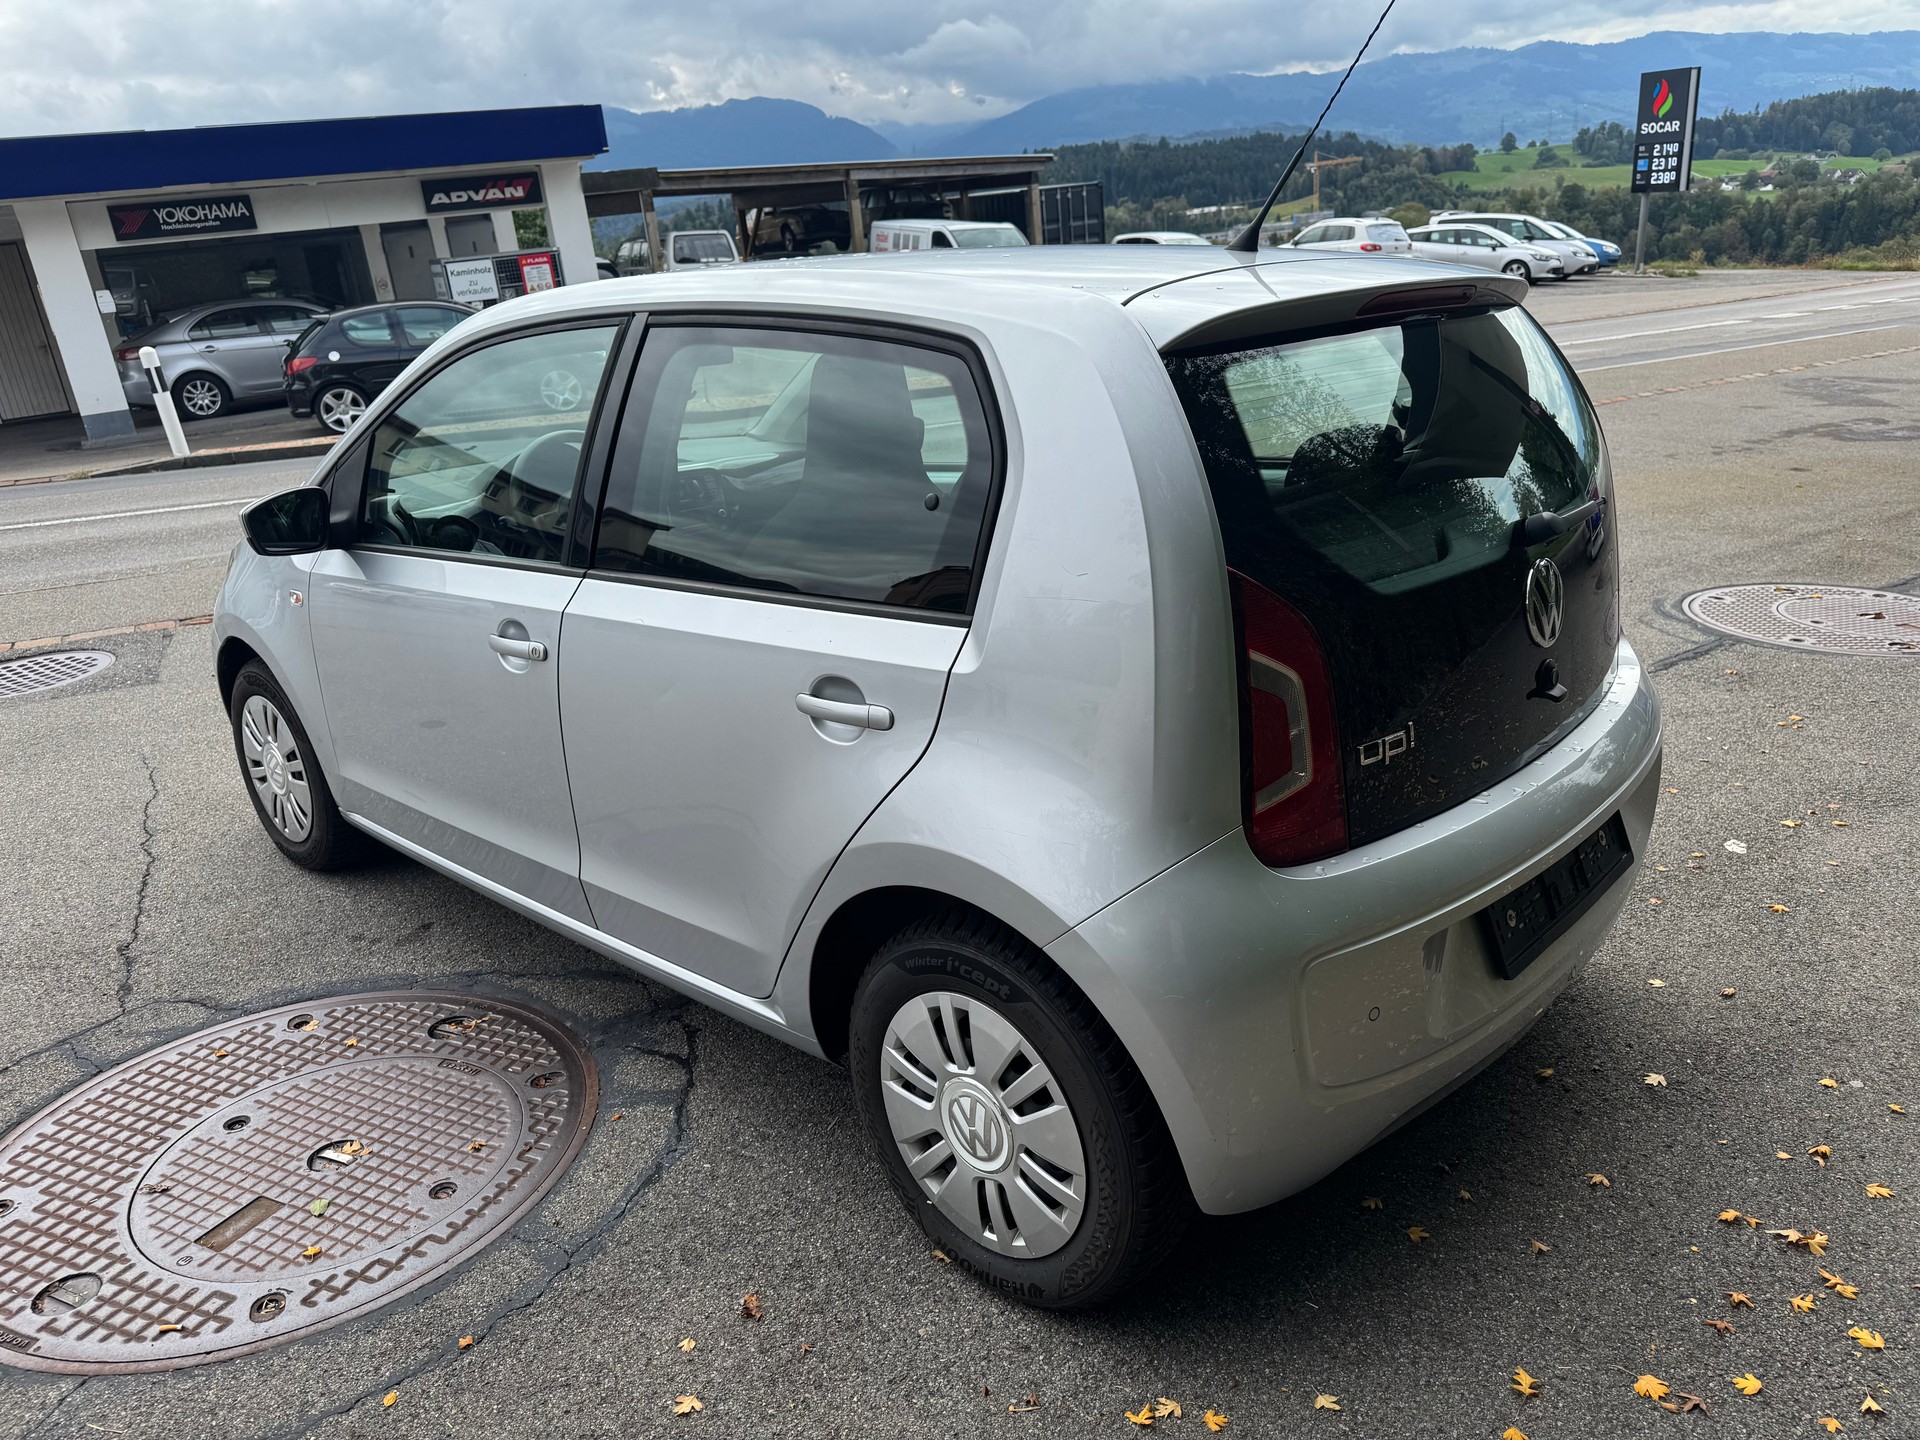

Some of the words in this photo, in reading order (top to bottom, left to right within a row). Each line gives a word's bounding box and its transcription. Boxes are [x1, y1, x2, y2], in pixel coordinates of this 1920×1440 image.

[1640, 120, 1680, 134] SOCAR
[430, 186, 525, 205] ADVAN
[153, 201, 250, 224] YOKOHAMA
[161, 220, 221, 231] Hochleistungsreifen
[450, 266, 492, 277] Kaminholz
[456, 286, 494, 297] verkaufen
